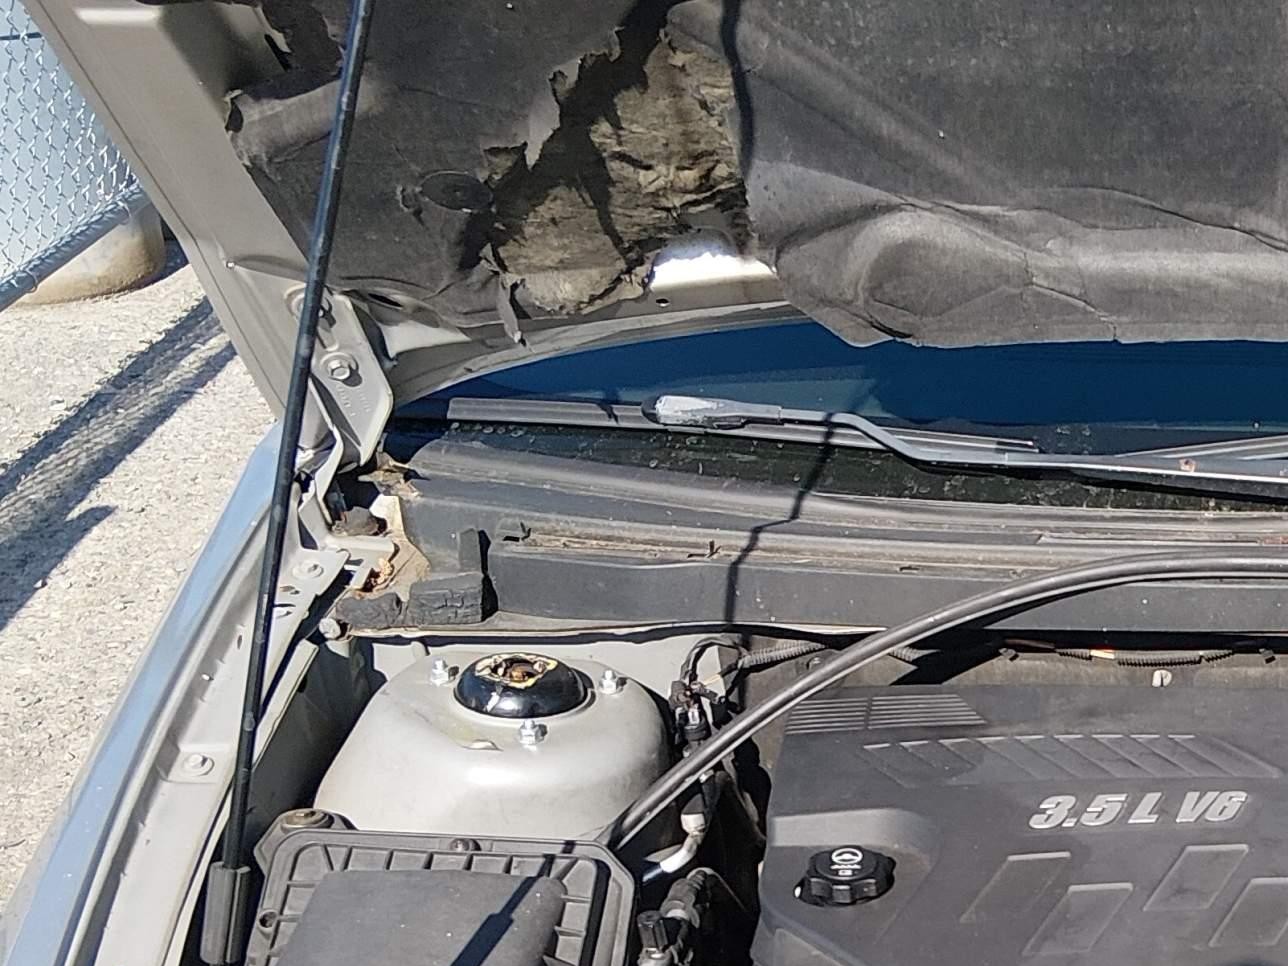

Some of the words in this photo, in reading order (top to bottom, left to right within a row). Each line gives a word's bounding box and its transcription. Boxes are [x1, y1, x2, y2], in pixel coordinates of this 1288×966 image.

[1028, 793, 1129, 830] 3.5
[1127, 792, 1163, 824] L
[1175, 790, 1248, 824] V6
